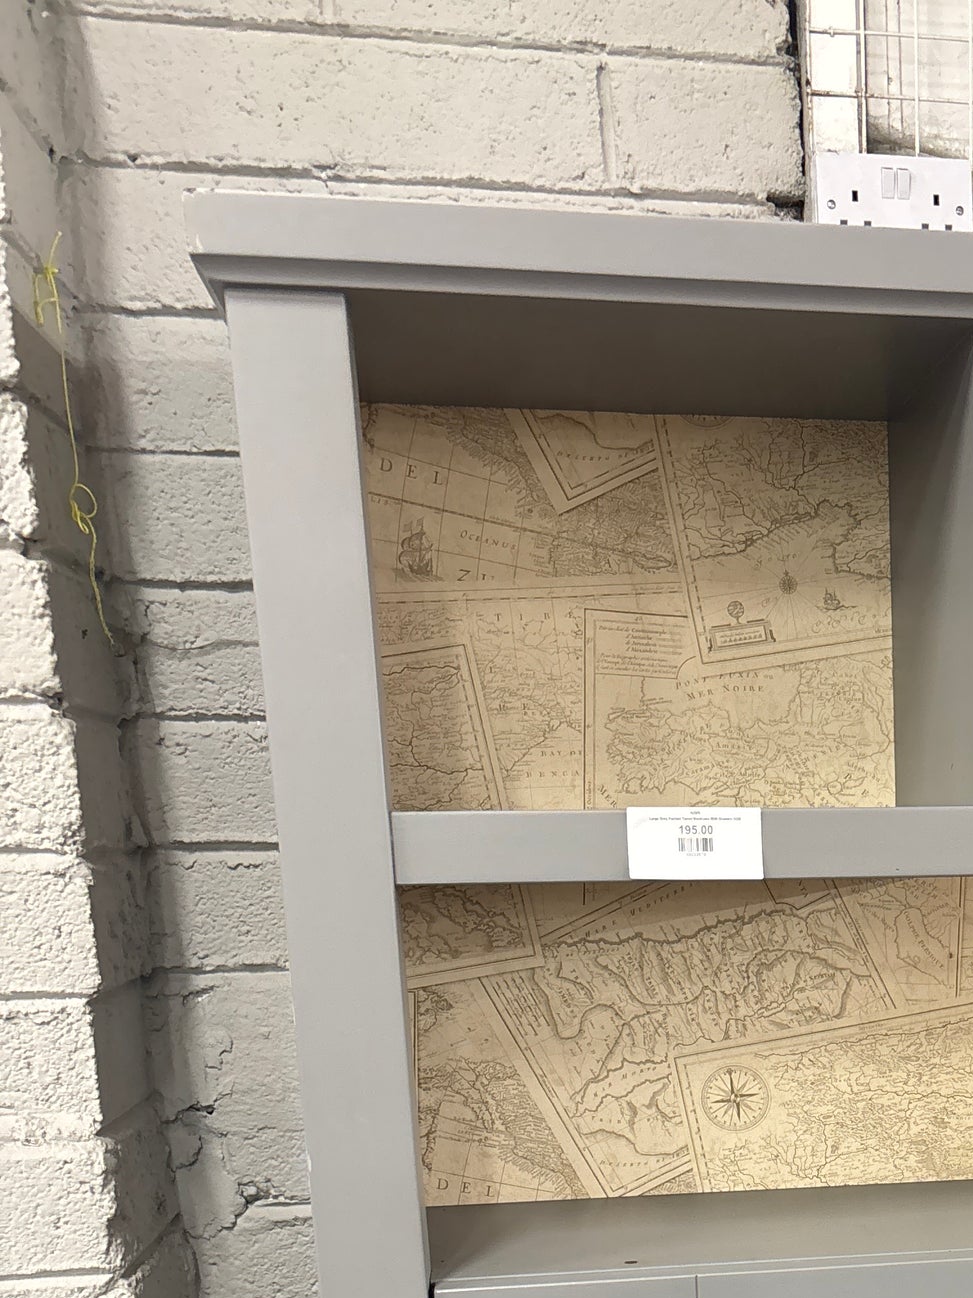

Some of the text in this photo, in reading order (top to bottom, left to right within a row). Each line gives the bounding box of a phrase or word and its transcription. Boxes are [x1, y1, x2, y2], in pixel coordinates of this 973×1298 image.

[379, 457, 444, 487] DEL
[459, 529, 519, 551] OCEANUS
[679, 824, 714, 835] 195.00
[437, 1178, 496, 1198] DEL
